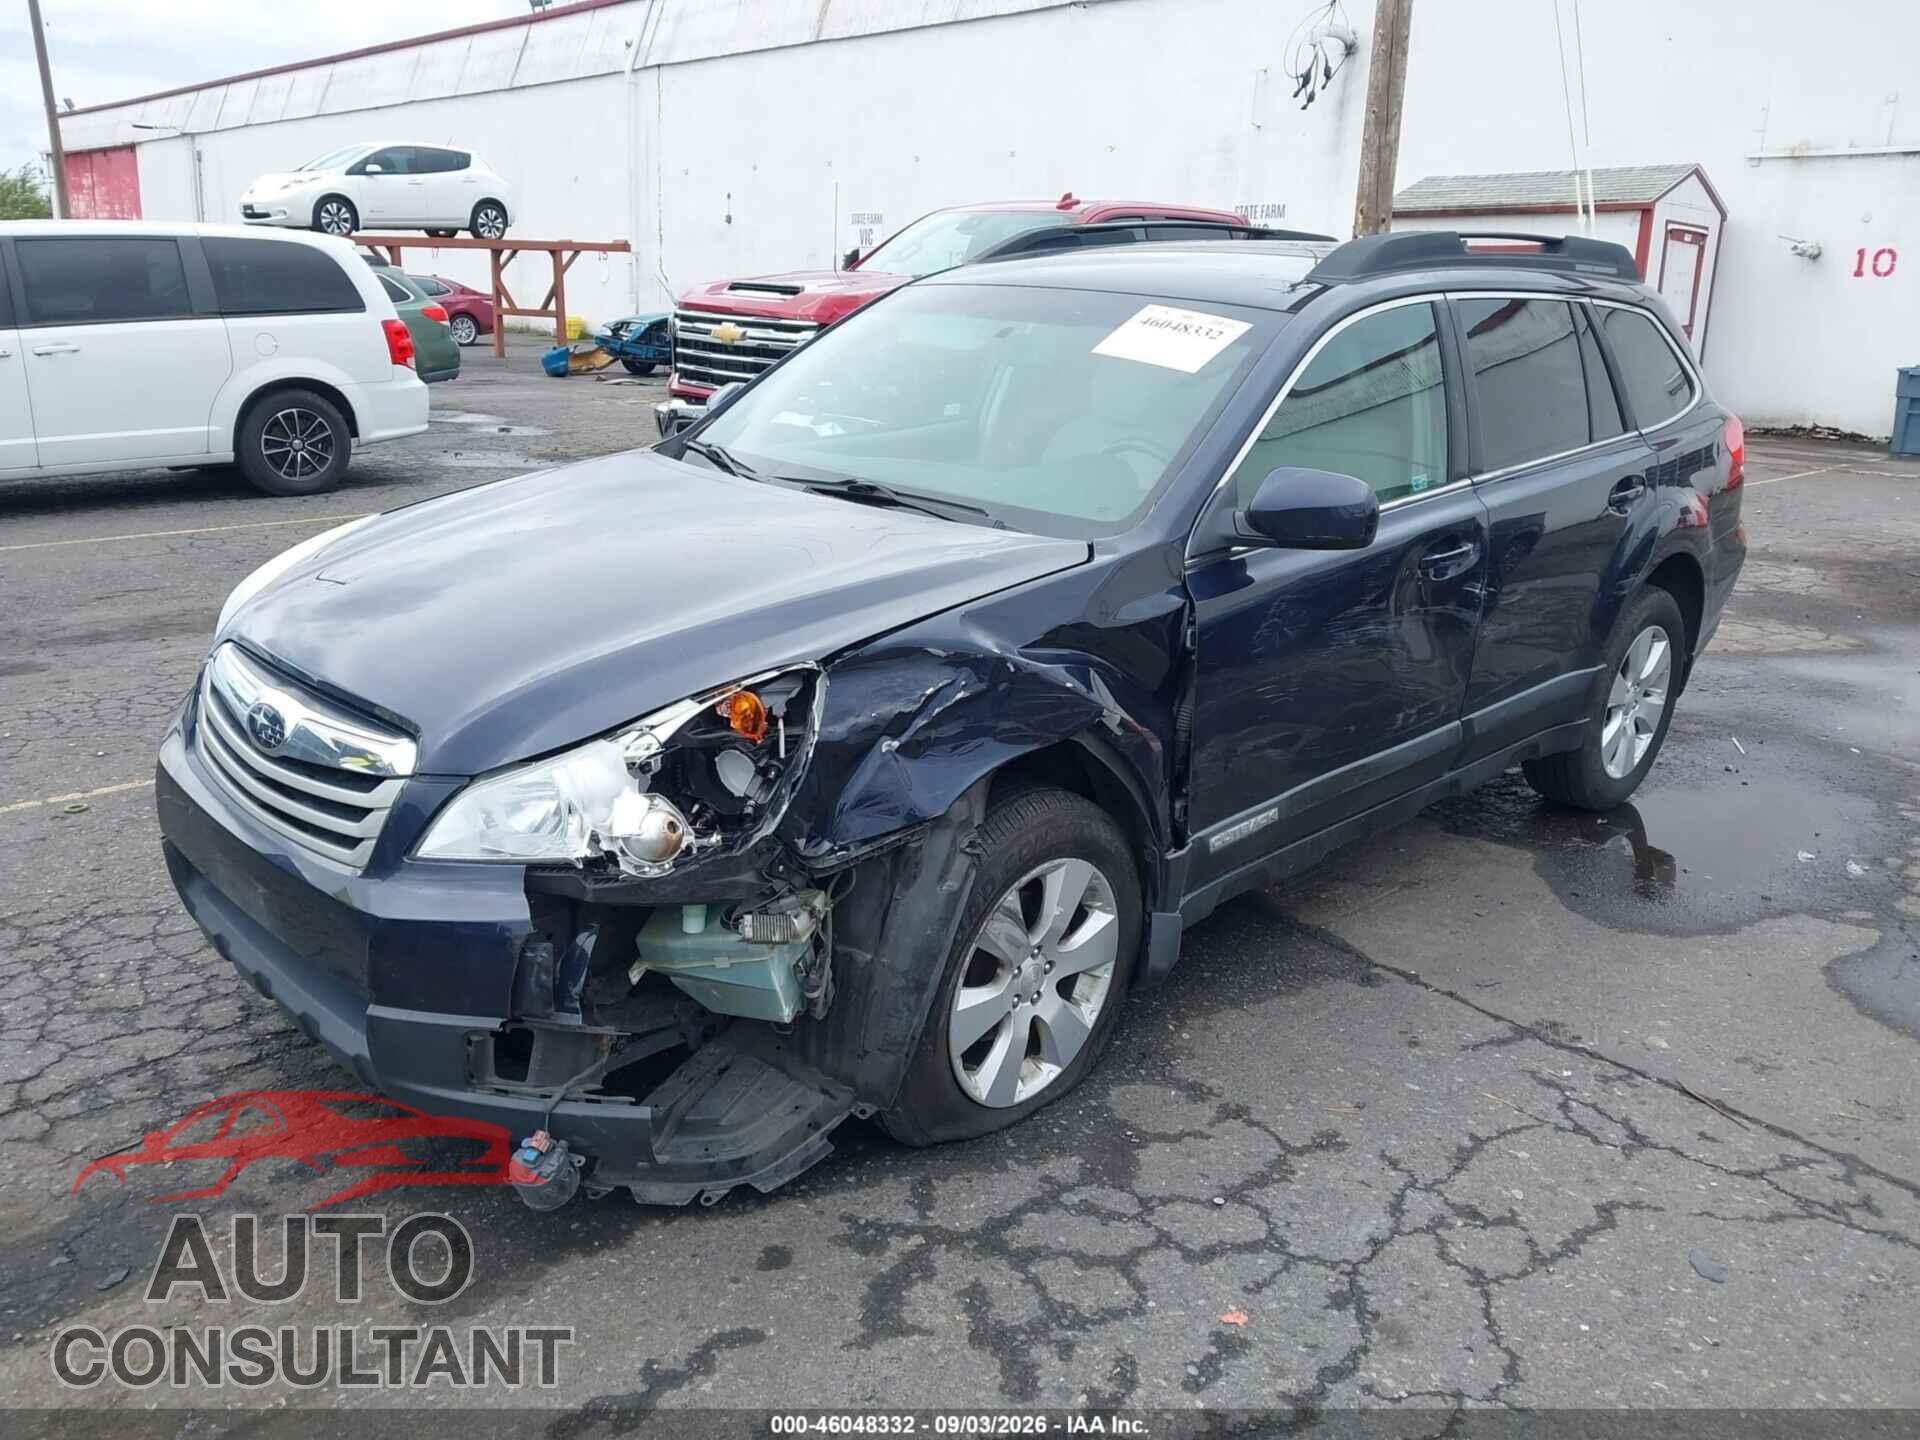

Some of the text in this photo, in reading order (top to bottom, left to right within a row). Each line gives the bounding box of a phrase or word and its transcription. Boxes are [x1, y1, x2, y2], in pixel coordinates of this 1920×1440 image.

[1260, 203, 1286, 220] FARM
[859, 228, 873, 246] VIC
[1853, 248, 1897, 278] 10
[1140, 317, 1224, 341] 46048332
